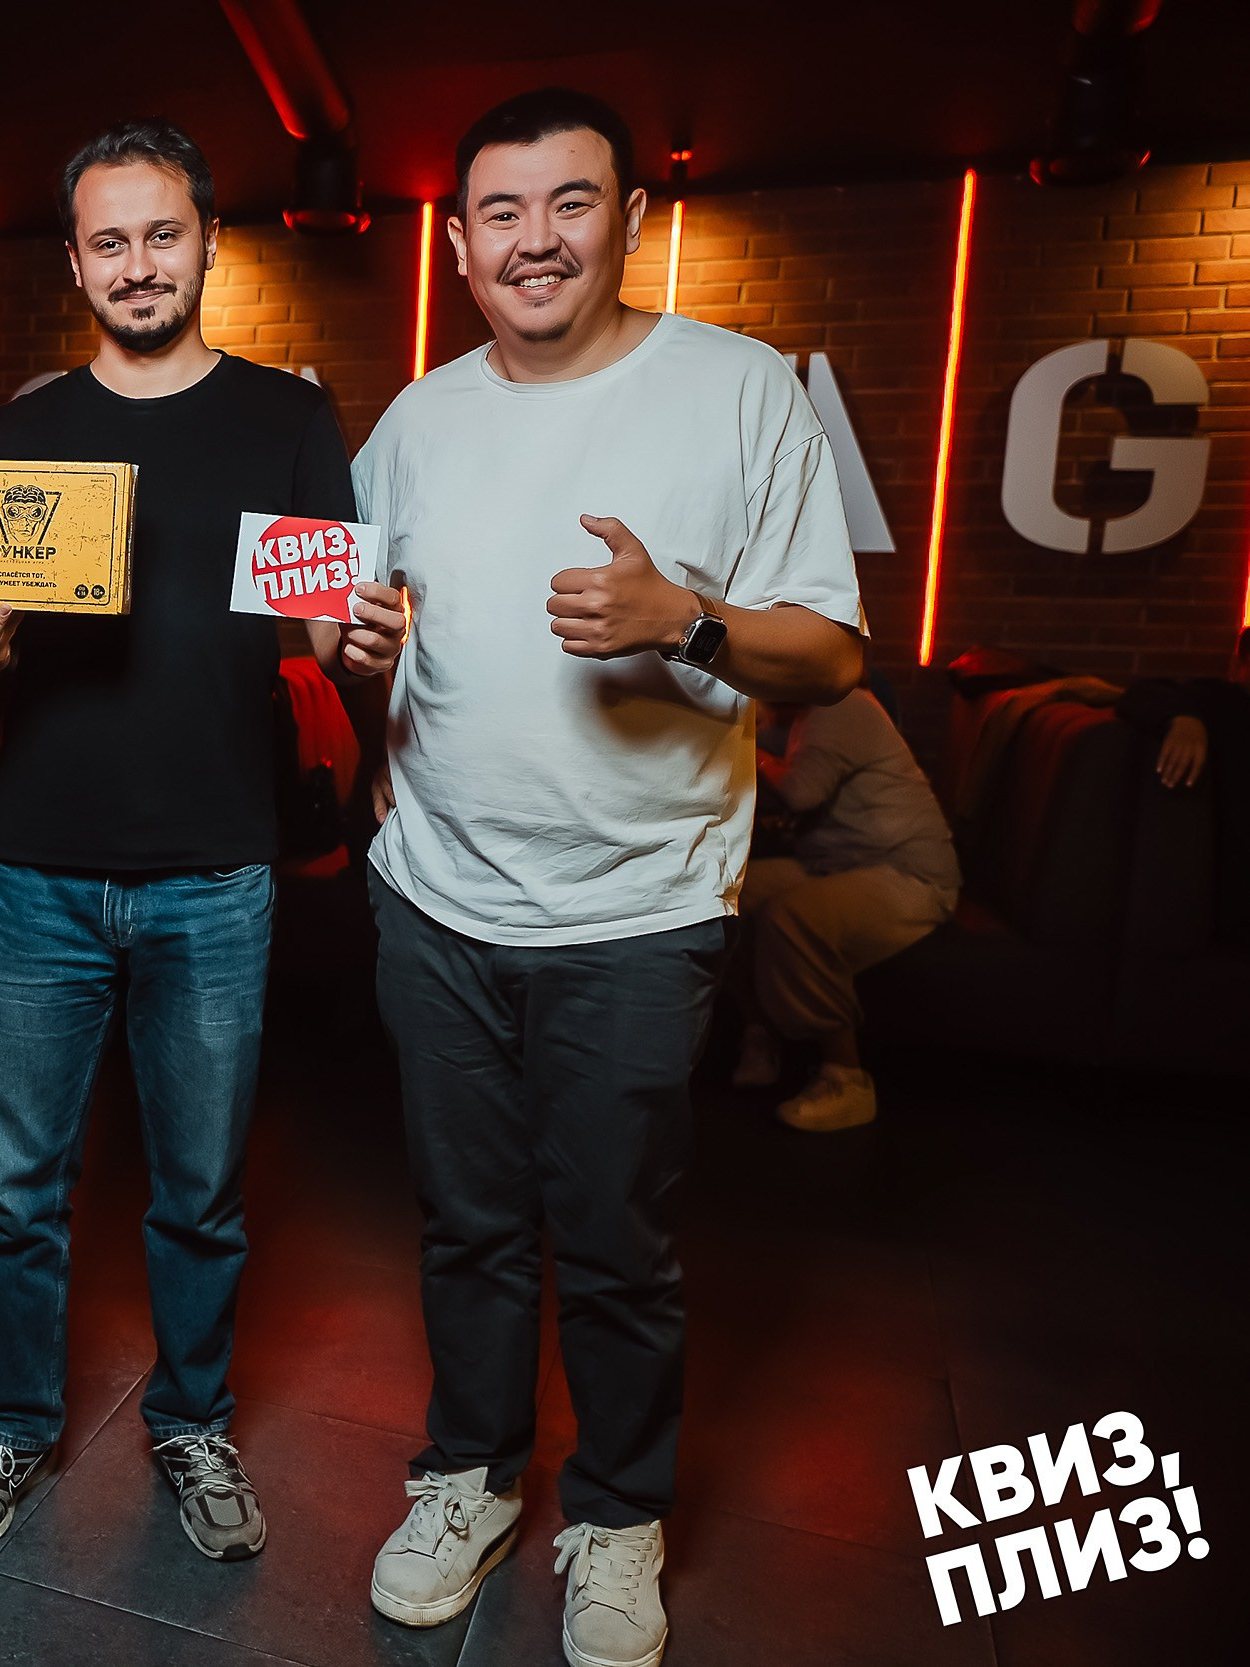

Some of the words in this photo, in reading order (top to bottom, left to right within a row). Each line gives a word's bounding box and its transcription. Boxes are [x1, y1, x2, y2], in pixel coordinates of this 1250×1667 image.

[255, 526, 359, 570] КВИЗ,
[32, 572, 46, 580] ТОТ,
[255, 557, 360, 601] ПЛИЗ!
[93, 588, 104, 596] 18+
